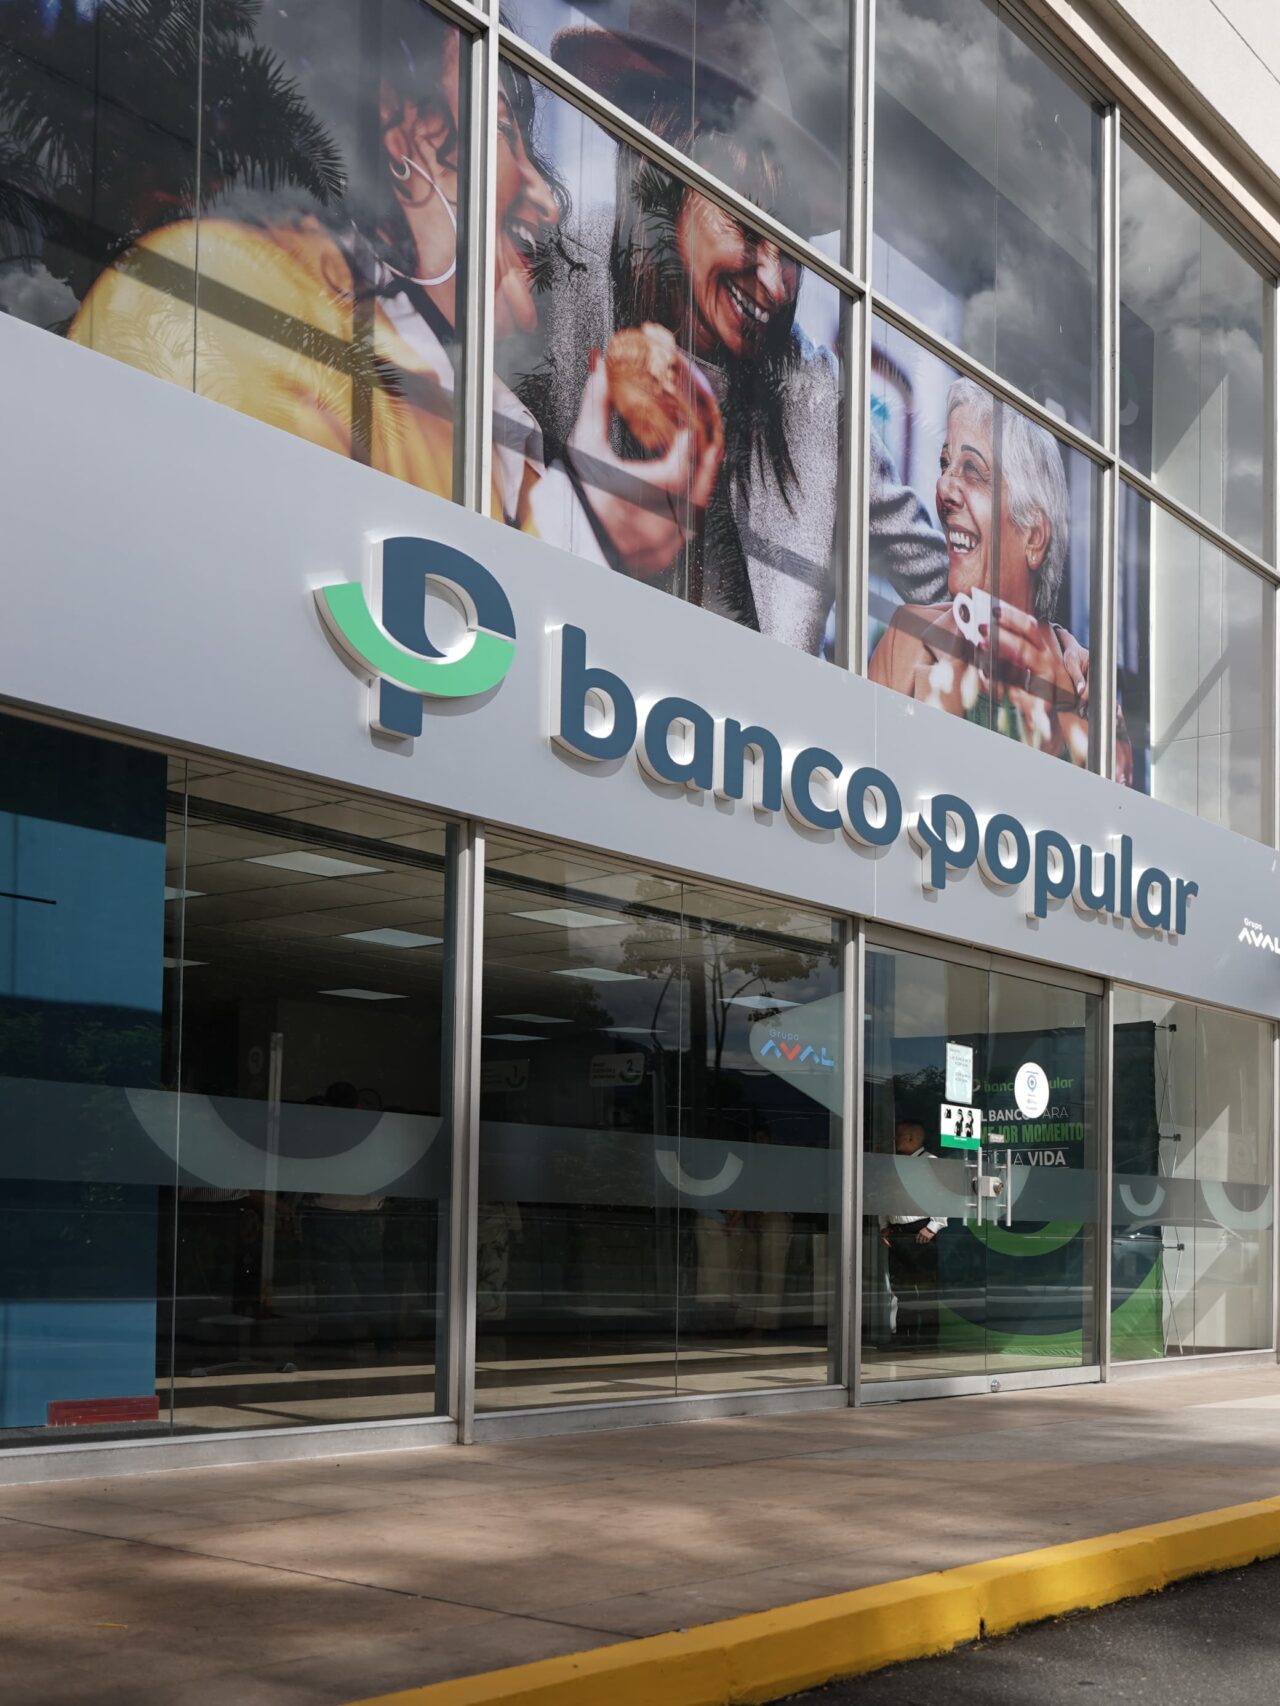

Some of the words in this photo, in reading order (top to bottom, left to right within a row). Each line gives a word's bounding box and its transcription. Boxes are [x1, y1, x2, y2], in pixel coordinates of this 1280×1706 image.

[554, 623, 903, 847] banco
[908, 794, 1199, 936] popular
[1244, 917, 1263, 931] Grupo
[769, 1029, 800, 1041] Grupo
[760, 1039, 834, 1067] AVAL
[1022, 1121, 1084, 1143] MOMENTO
[1027, 1150, 1067, 1166] VIDA
